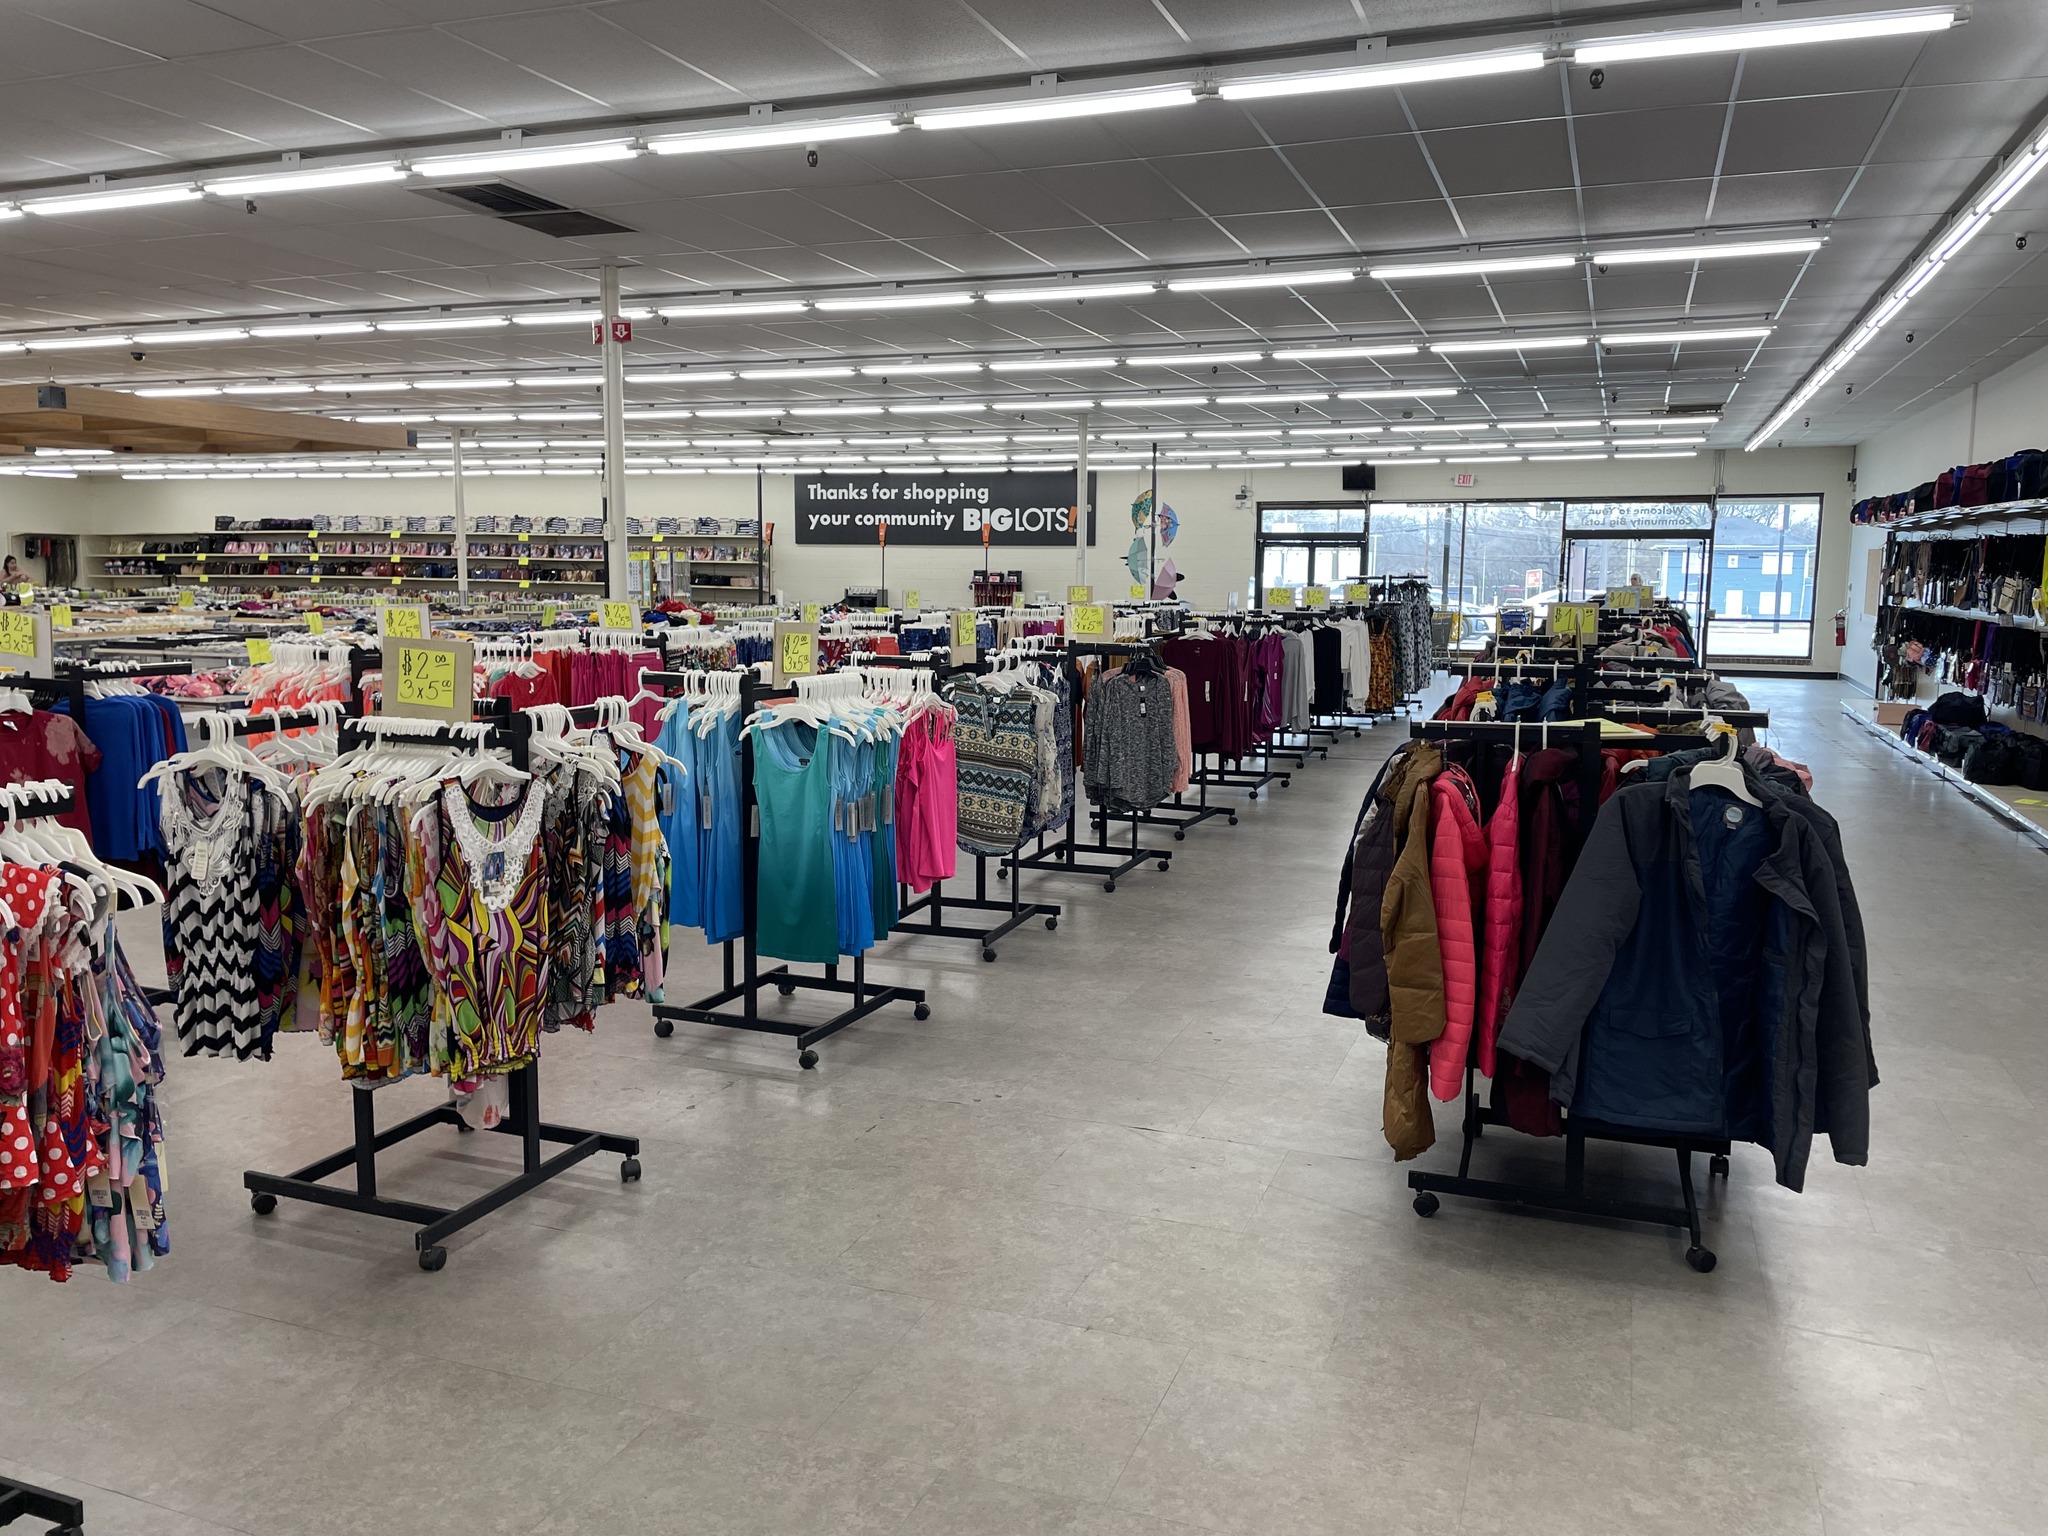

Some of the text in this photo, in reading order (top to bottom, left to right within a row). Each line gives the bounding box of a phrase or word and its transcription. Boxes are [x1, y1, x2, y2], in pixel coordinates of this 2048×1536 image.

[1457, 473, 1472, 485] EXIT
[807, 482, 989, 504] Thanks for shopping
[808, 514, 851, 530] your
[854, 509, 955, 530] community
